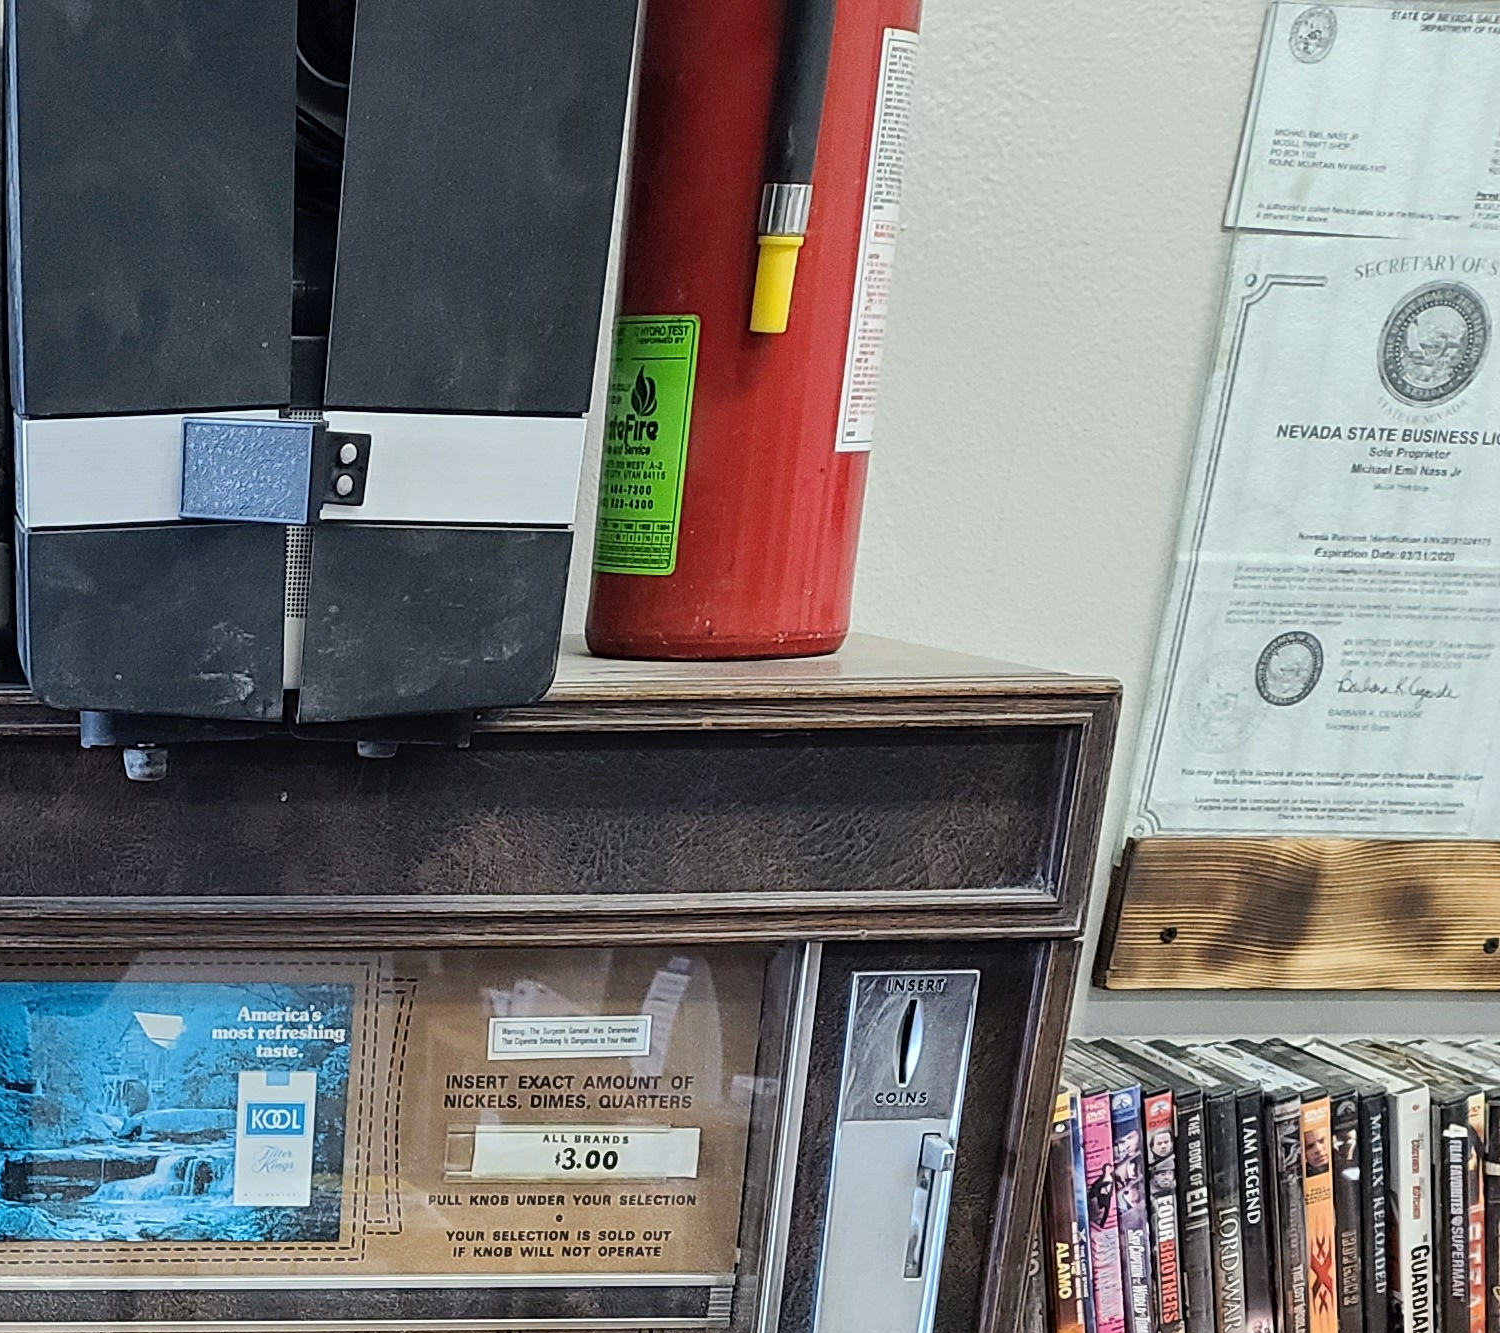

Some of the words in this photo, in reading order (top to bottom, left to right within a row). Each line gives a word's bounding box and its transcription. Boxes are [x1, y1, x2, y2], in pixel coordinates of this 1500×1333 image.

[1354, 255, 1456, 280] SECRETARY
[668, 325, 690, 337] TEST
[1276, 424, 1342, 439] NEVADA
[1347, 426, 1398, 442] STATE
[1401, 428, 1479, 445] BUSINESS
[1368, 446, 1394, 458] Sole
[1397, 447, 1451, 460] Proprietor
[1350, 463, 1393, 475] Michael
[1395, 465, 1418, 476] Emil
[1420, 465, 1448, 477] Nass
[1450, 466, 1463, 478] Jr
[1314, 547, 1368, 560] Expiration
[887, 977, 947, 993] INSERT
[237, 1004, 322, 1022] America's
[212, 1026, 256, 1040] most
[258, 1024, 346, 1043] refreshing
[256, 1044, 304, 1058] taste.
[446, 1075, 508, 1090] INSERT
[518, 1075, 575, 1090] EXACT
[583, 1075, 662, 1090] AMOUNT
[671, 1075, 695, 1090] OF
[444, 1094, 522, 1110] NICKELS,
[530, 1094, 592, 1110] DIMES,
[599, 1094, 692, 1109] QUARTERS
[874, 1091, 928, 1105] COINS
[251, 1108, 301, 1130] KOOL
[1187, 1113, 1201, 1137] THE
[1242, 1116, 1257, 1124] I
[542, 1134, 568, 1144] ALL
[574, 1135, 630, 1145] BRANDS
[1443, 1123, 1469, 1138] 4
[1243, 1128, 1258, 1155] AM
[1369, 1113, 1385, 1188] MATRIX
[1449, 1139, 1463, 1164] FILM
[554, 1147, 619, 1171] $3.00
[1188, 1140, 1203, 1172] BOOK
[1189, 1173, 1203, 1186] OF
[1244, 1159, 1261, 1225] LEGEND
[1450, 1164, 1464, 1216] FAVORITES
[428, 1195, 462, 1206] PULL
[469, 1195, 509, 1206] KNOB
[516, 1195, 565, 1206] UNDER
[573, 1195, 612, 1206] YOUR
[619, 1195, 697, 1206] SELECTION
[1186, 1186, 1208, 1218] ELI
[1157, 1195, 1175, 1242] FOUR
[446, 1231, 484, 1242] YOUR
[492, 1231, 569, 1242] SELECTION
[577, 1231, 590, 1241] IS
[598, 1231, 635, 1242] SOLD
[642, 1231, 672, 1242] OUT
[1219, 1205, 1241, 1272] LORD
[1373, 1196, 1388, 1295] RELOADED
[453, 1246, 465, 1257] IF
[473, 1246, 512, 1257] KNOB
[520, 1246, 554, 1257] WILL
[561, 1246, 591, 1257] NOT
[598, 1246, 662, 1257] OPERATE
[1451, 1225, 1466, 1298] SUPERMAN
[1055, 1242, 1073, 1300] ALAMO
[1159, 1240, 1180, 1324] BROTHERS
